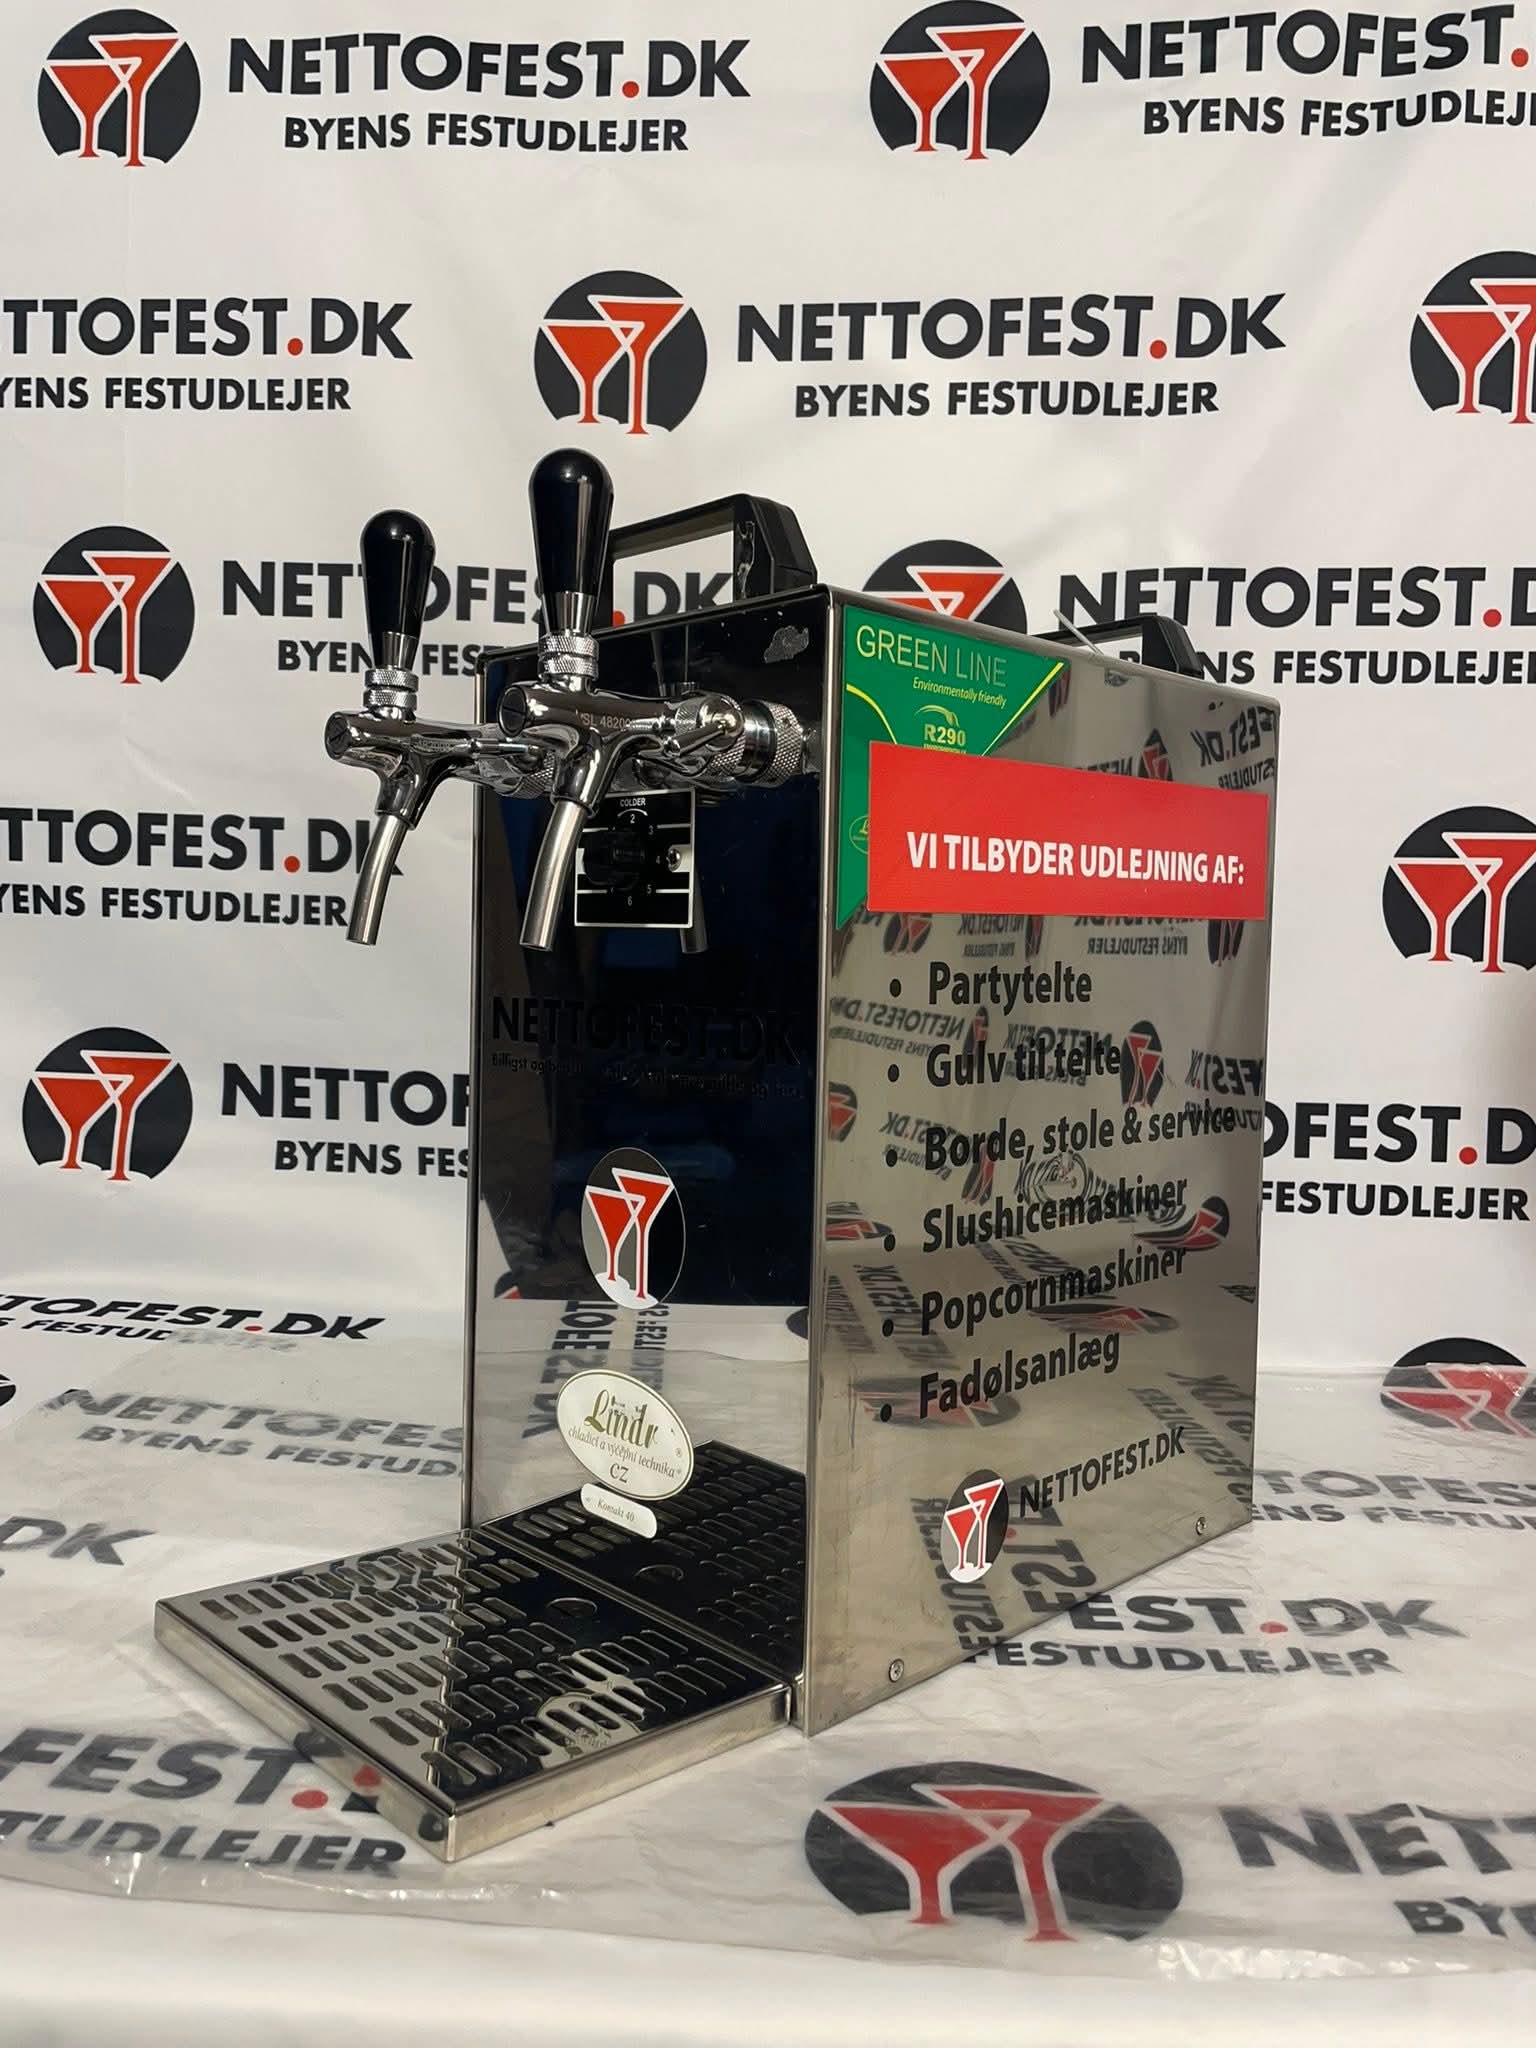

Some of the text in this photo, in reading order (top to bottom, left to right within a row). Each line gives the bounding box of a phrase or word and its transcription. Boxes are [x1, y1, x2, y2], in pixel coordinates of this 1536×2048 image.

[228, 33, 751, 99] NETTOFEST.DK
[284, 113, 690, 153] BYENS FESTUDLEJER
[1143, 96, 1286, 135] BYENS
[3, 297, 414, 360] TTOFEST.DK
[738, 292, 1287, 363] NETTOFEST.DK
[105, 376, 351, 411] FESTUDLEJER
[795, 379, 1219, 418] BYENS FESTUDLEJER
[856, 624, 1006, 687] GREEN LINE
[913, 677, 1007, 709] Environmentally friendly
[924, 723, 966, 747] R290
[619, 797, 646, 807] COLDER
[629, 813, 636, 824] 2
[907, 832, 1245, 885] VI TILBYDER UDLEJNING AF:
[102, 887, 349, 928] FESTUDLEJER
[627, 895, 633, 907] 6
[929, 961, 1091, 1016] Partytelte
[927, 1042, 1007, 1087] Gulv
[1014, 1037, 1046, 1081] til
[1053, 1035, 1122, 1079] telte
[925, 1117, 1034, 1172] Borde,
[1043, 1109, 1114, 1155] stole
[1121, 1106, 1143, 1145] &
[1148, 1098, 1235, 1143] service
[275, 1140, 403, 1175] BYENS
[922, 1175, 1188, 1253] Slushicemaskiner
[920, 1246, 1186, 1338] Popcornmaskiner
[919, 1331, 1121, 1420] Fadølsanlæg
[77, 1426, 254, 1456] BYENS
[609, 1462, 629, 1484] CZ
[638, 1454, 676, 1479] technika
[1018, 1426, 1186, 1518] NETTOFEST.DK
